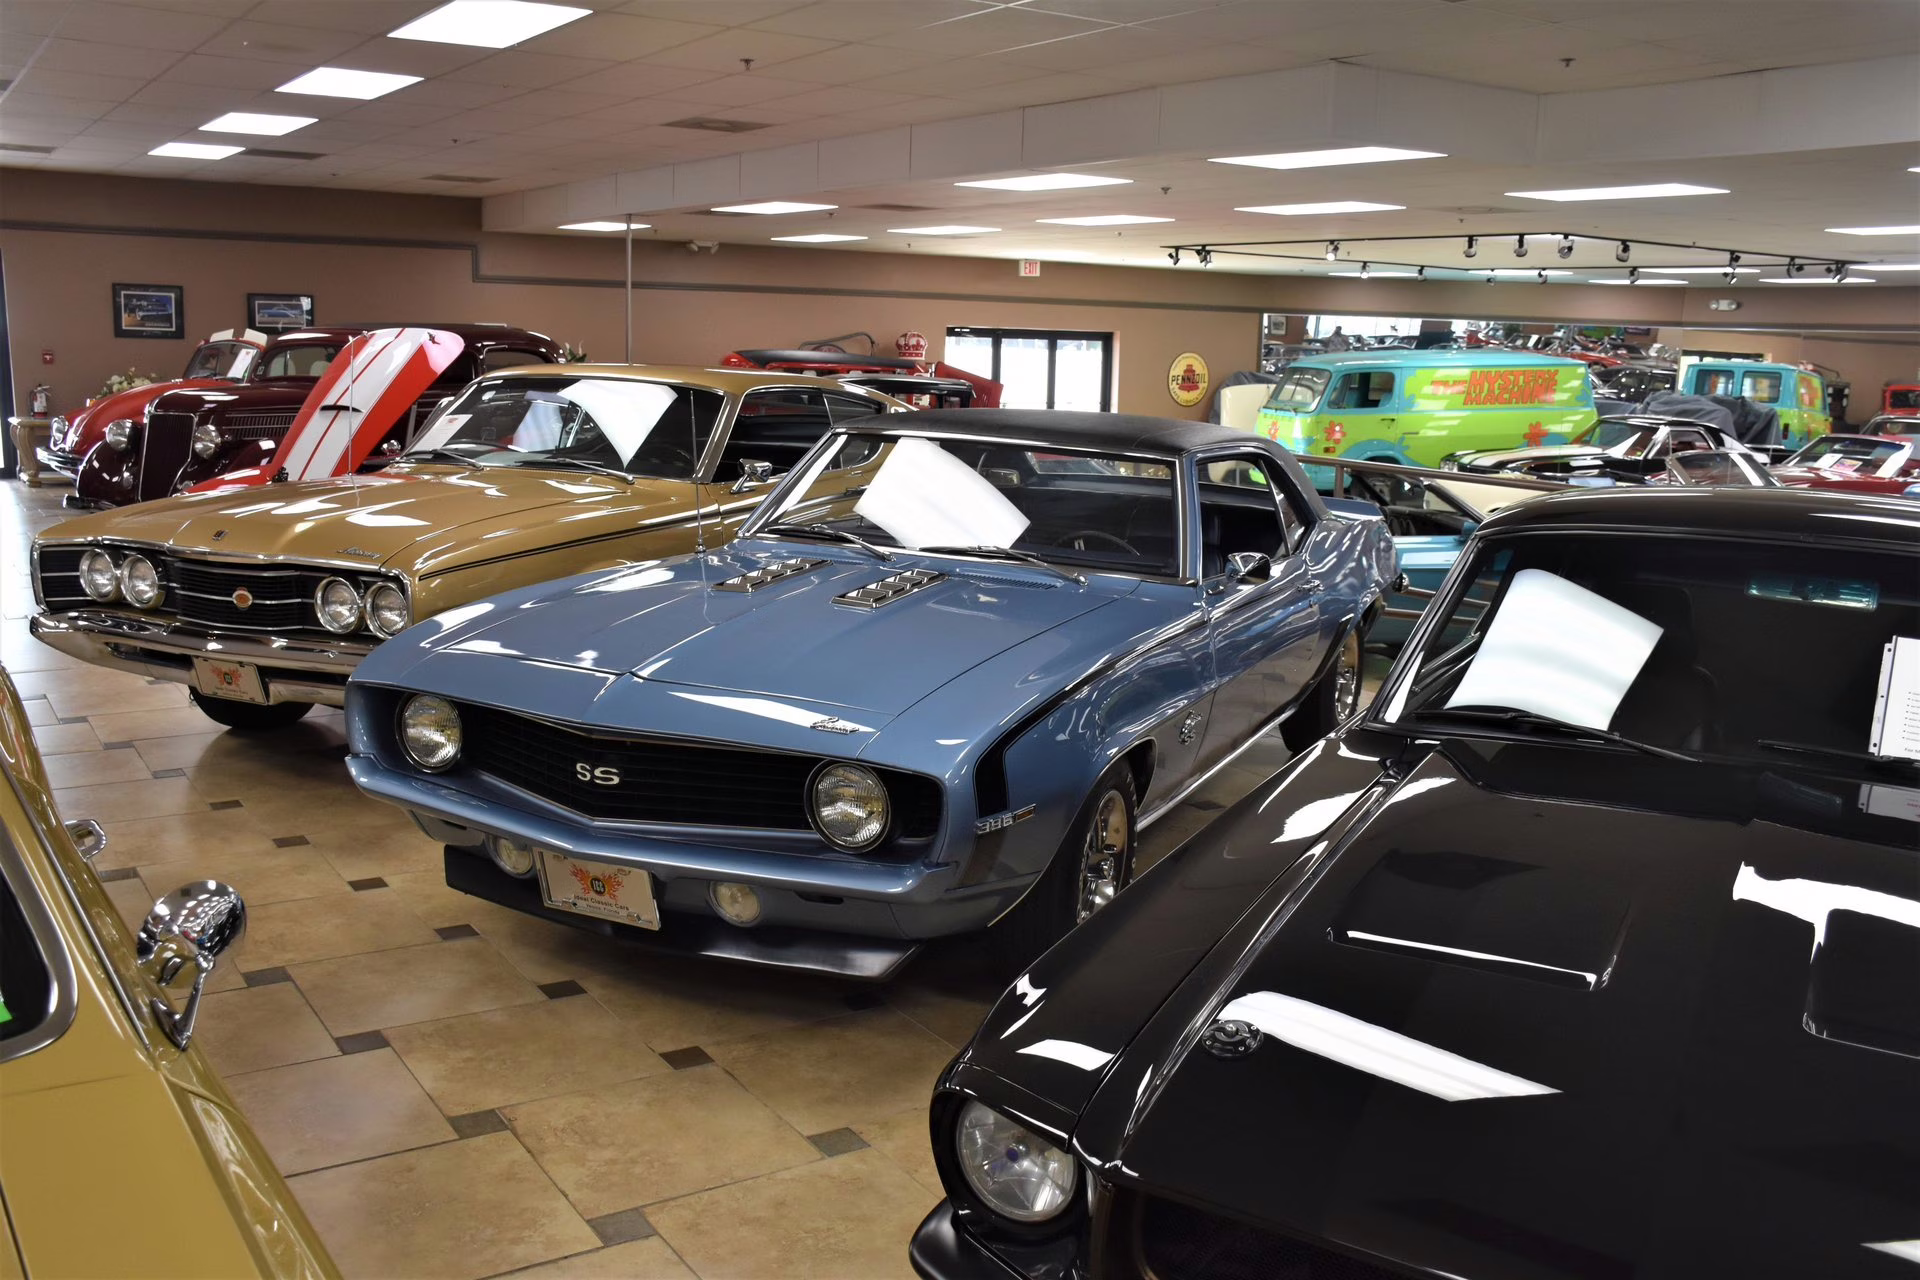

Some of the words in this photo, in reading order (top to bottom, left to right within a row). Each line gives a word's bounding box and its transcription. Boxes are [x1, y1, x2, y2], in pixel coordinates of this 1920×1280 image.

[1023, 261, 1038, 275] EXIT
[1171, 373, 1207, 385] PENNZOIL
[1431, 379, 1468, 395] THE
[1467, 369, 1559, 395] MYSTERY
[1464, 379, 1558, 406] MACHINE
[576, 763, 620, 785] SS
[976, 813, 1013, 834] 396
[591, 897, 614, 907] Classic
[614, 903, 630, 911] Cars
